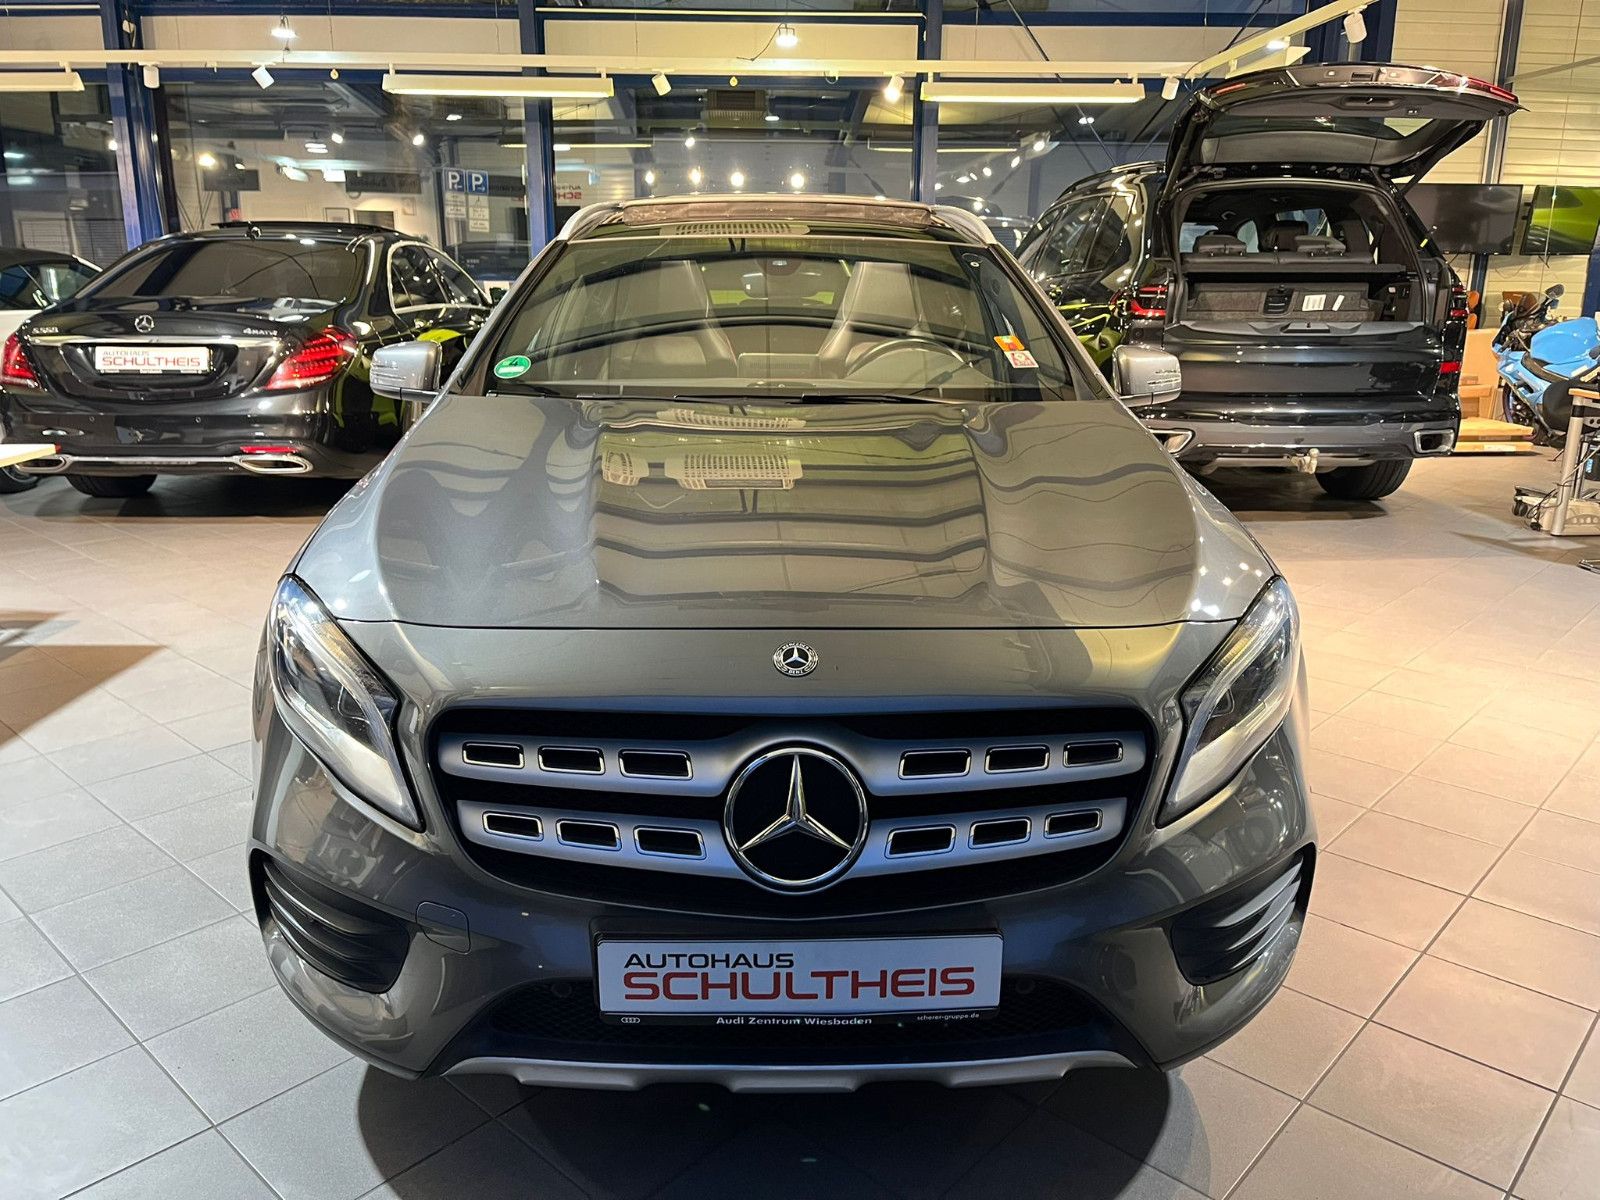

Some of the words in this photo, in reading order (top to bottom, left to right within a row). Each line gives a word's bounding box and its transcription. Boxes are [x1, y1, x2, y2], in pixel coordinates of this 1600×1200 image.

[448, 171, 460, 189] P
[471, 173, 483, 191] P
[102, 356, 201, 366] SCHULTHEIS
[624, 953, 794, 969] AUTOHAUS
[623, 966, 976, 1001] SCHULTHEIS
[716, 1016, 744, 1026] Audi
[748, 1016, 800, 1026] Zentrum
[804, 1017, 873, 1026] Wiesbaden
[917, 1012, 980, 1020] scherer-gruppe.de
